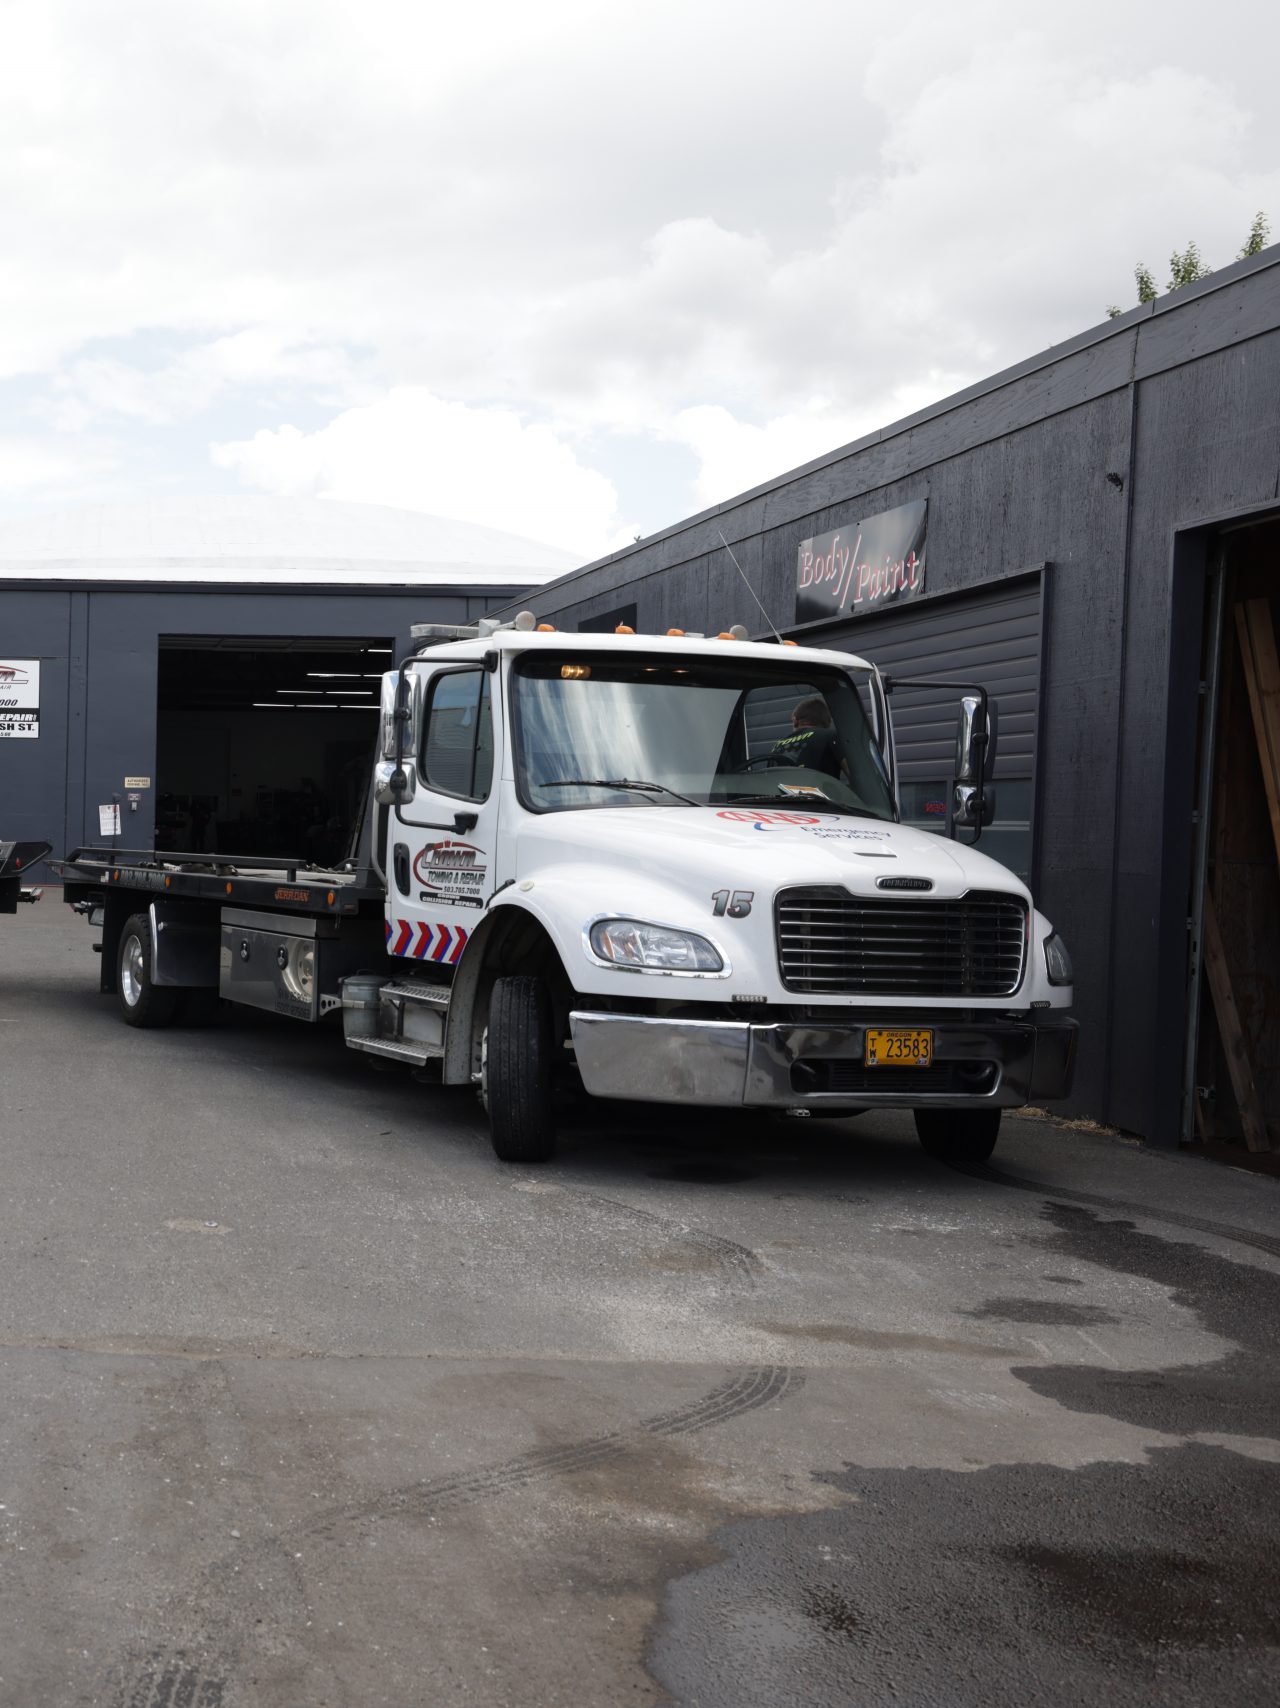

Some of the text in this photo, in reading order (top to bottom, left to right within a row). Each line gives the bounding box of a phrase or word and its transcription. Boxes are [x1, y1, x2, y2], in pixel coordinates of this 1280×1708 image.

[18, 723, 35, 731] ST.
[800, 826, 892, 838] Emergency
[814, 832, 883, 841] Services
[428, 871, 485, 886] TOWING & REPAIR
[443, 886, 480, 895] 503.705.7000
[422, 897, 453, 905] COLLISION
[711, 889, 755, 919] 15
[886, 1038, 929, 1058] 23583
